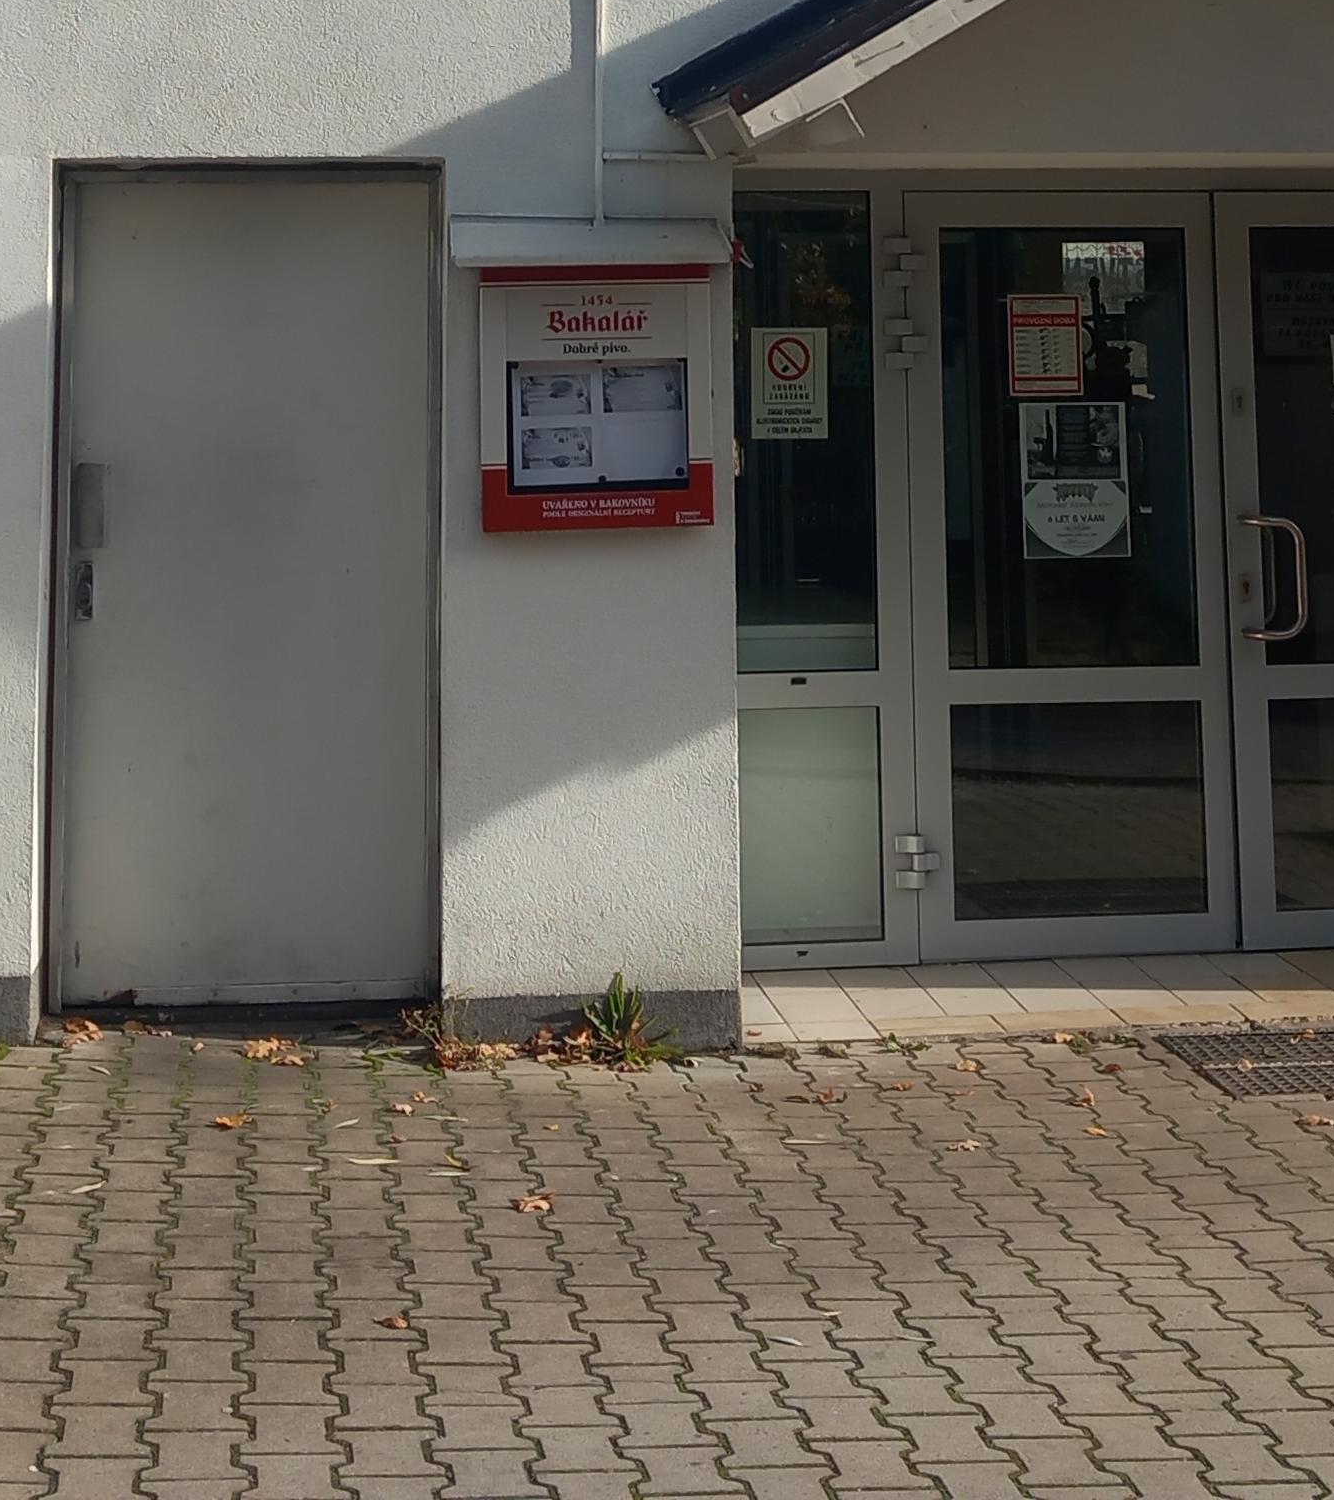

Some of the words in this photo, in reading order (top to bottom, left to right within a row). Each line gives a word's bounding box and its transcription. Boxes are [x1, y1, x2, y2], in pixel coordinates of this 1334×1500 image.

[580, 294, 614, 306] 1454
[546, 309, 649, 334] Bakalář
[562, 342, 599, 355] Dobré
[602, 343, 631, 356] pivo.
